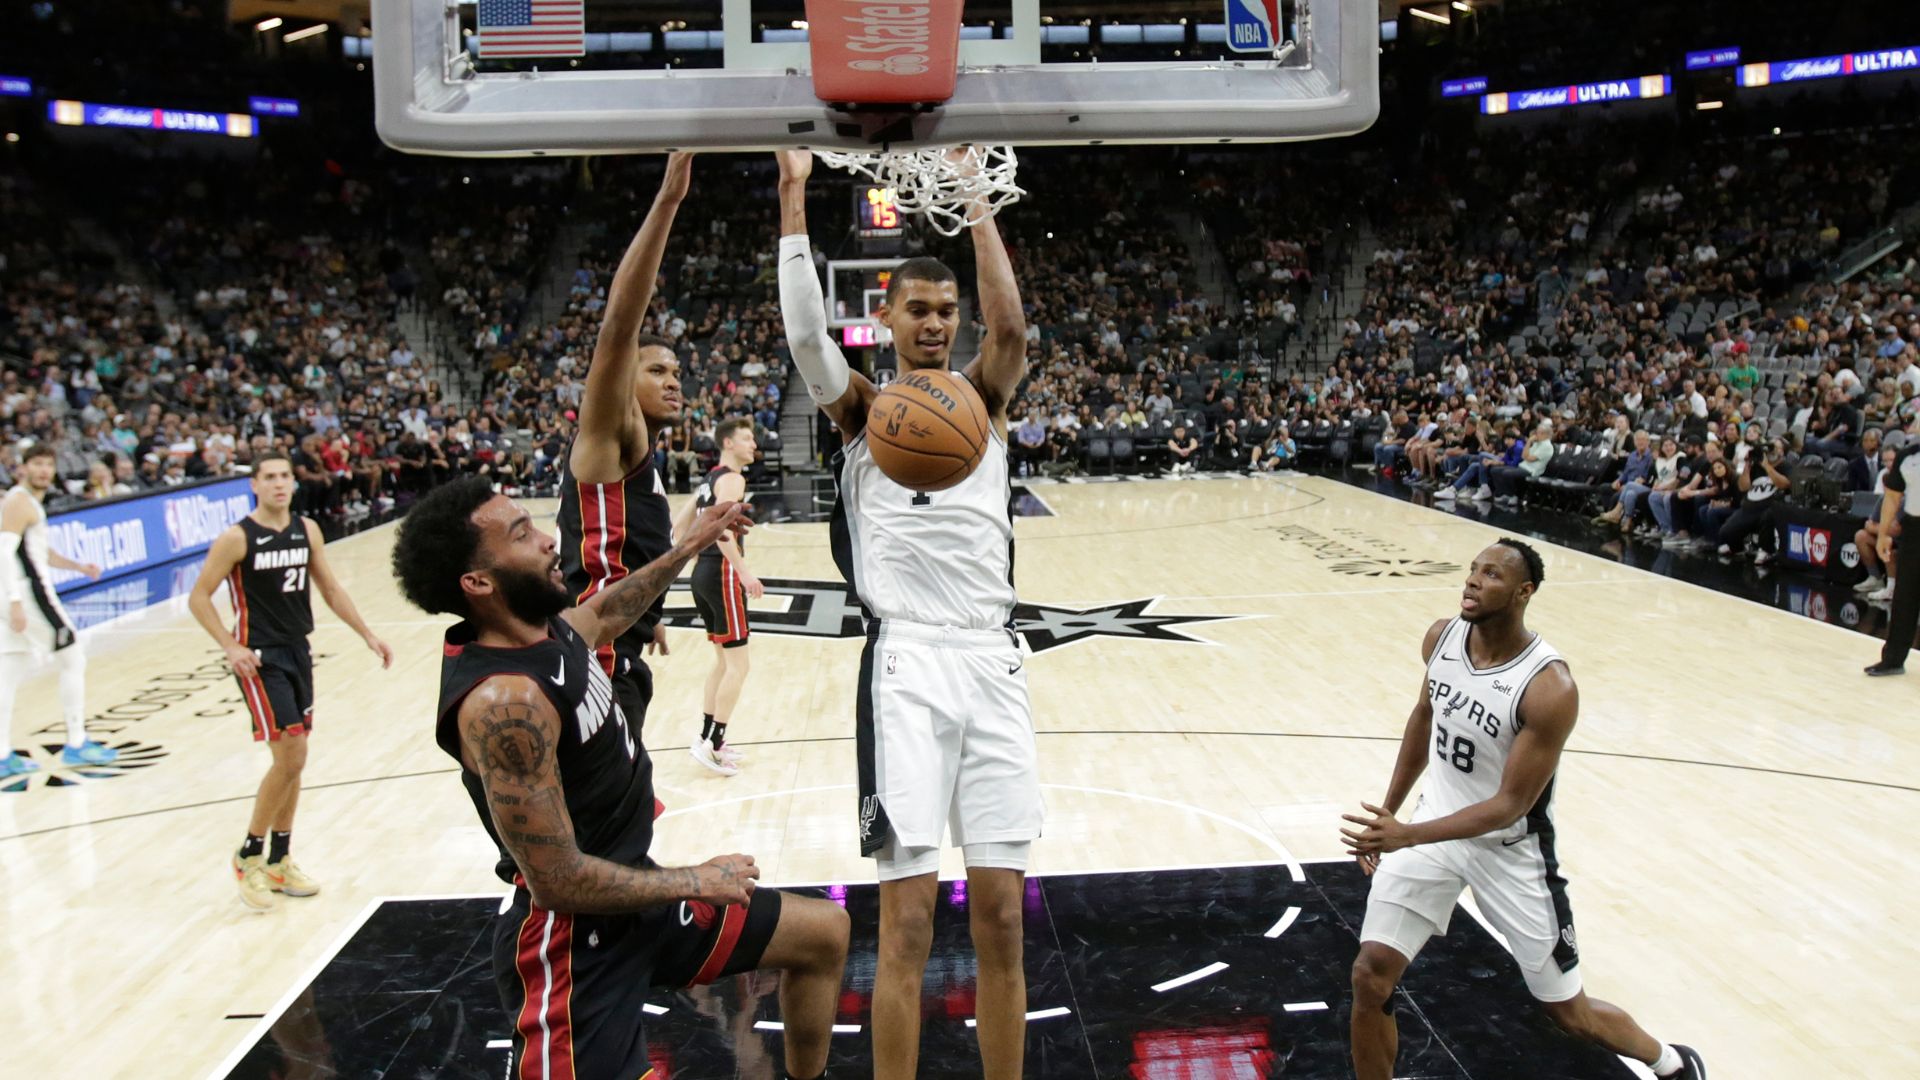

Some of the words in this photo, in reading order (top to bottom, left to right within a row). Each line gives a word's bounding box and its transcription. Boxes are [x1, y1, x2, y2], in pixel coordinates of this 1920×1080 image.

[842, 6, 930, 53] State
[1234, 23, 1262, 43] NBA
[1854, 50, 1918, 71] ULTRA
[1579, 81, 1630, 102] ULTRA
[163, 112, 220, 132] ULTRA
[873, 204, 897, 228] 15
[1813, 542, 1828, 554] TNT
[1842, 550, 1860, 561] TNT
[254, 547, 309, 571] MIAMI
[282, 567, 306, 592] 21
[1491, 679, 1514, 697] Self.
[1429, 679, 1501, 739] SPURS
[1436, 723, 1476, 774] 28
